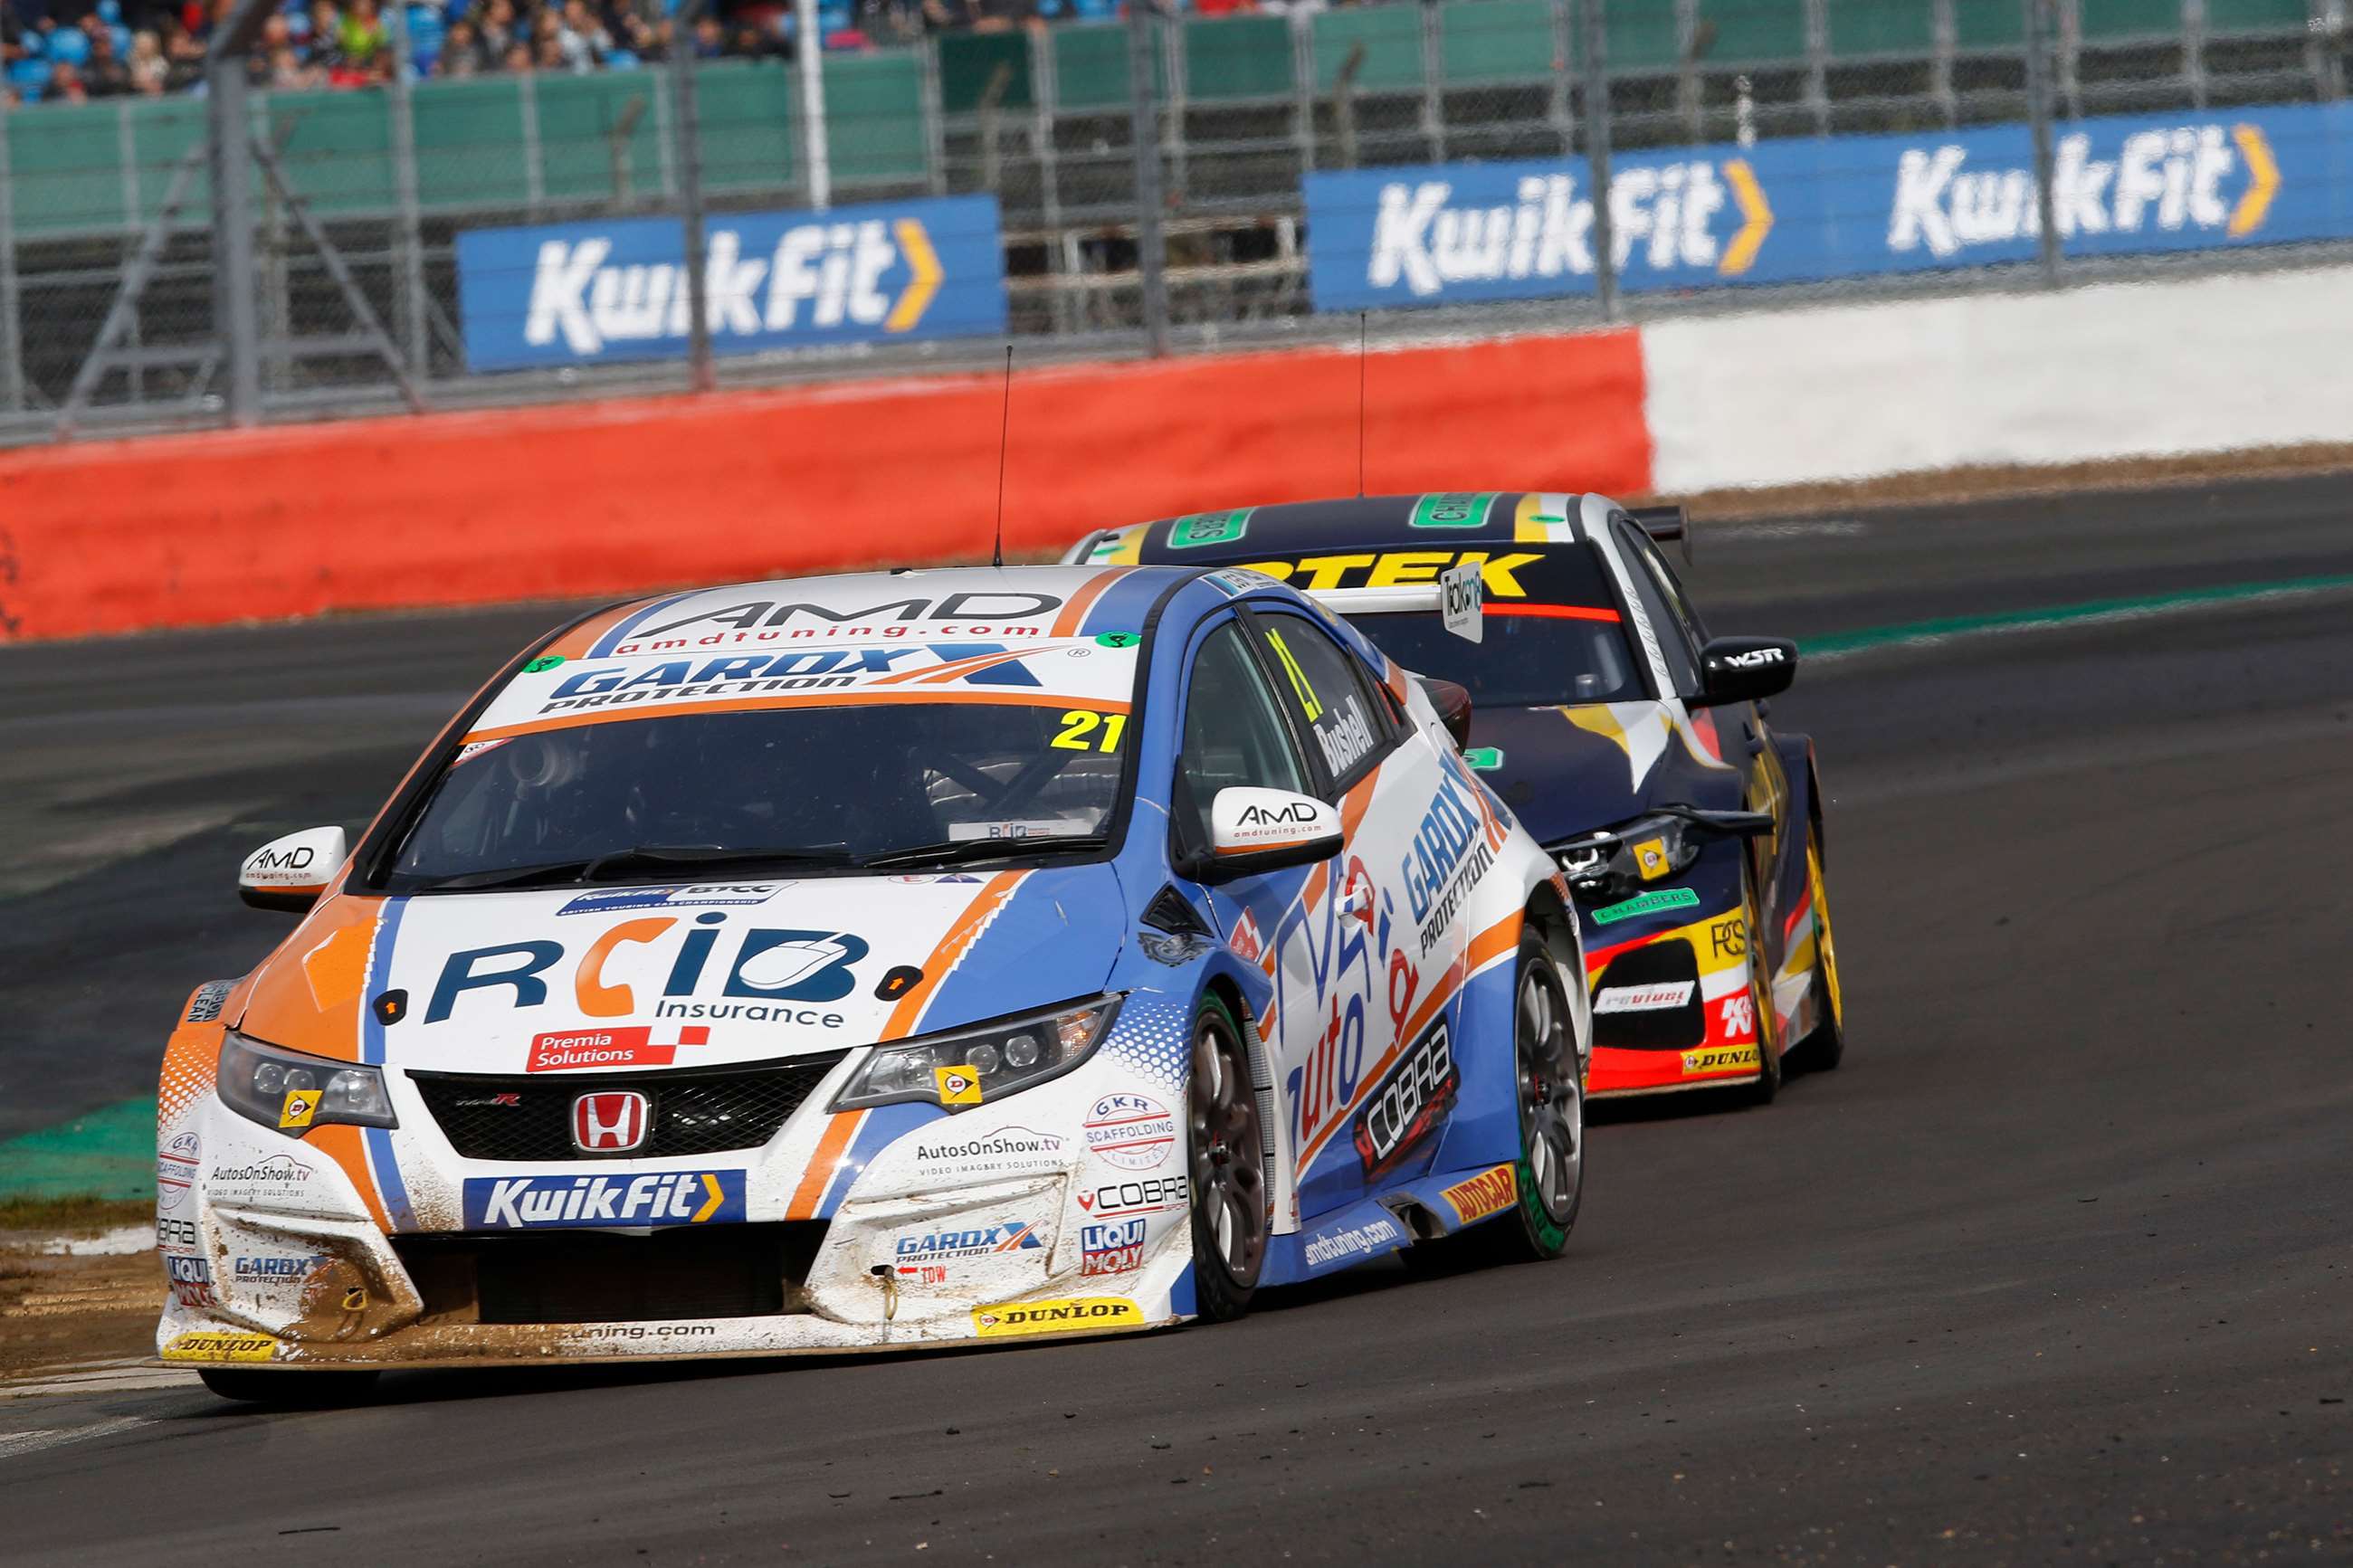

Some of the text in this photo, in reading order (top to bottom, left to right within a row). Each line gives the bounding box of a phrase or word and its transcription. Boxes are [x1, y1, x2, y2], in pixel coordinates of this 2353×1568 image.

[627, 593, 1062, 639] AMD
[615, 624, 1040, 654] amdtuning.com
[1724, 648, 1784, 668] WSR
[1265, 628, 1323, 722] 21
[538, 676, 857, 715] PROTECTION
[1051, 710, 1127, 753] 21
[1313, 695, 1374, 777] Bushell
[1236, 803, 1317, 826] AMD
[1234, 824, 1321, 838] amdtuning.com
[247, 848, 314, 870] AMD
[687, 885, 776, 894] BTCC
[1420, 841, 1495, 960] PROTECTION
[1601, 892, 1691, 918] CHAMBERS
[655, 999, 844, 1028] Insurance
[541, 1033, 612, 1050] Premia
[538, 1045, 634, 1066] Solutions
[1096, 1097, 1148, 1115] GKR
[1087, 1121, 1174, 1143] SCAFFOLDING
[918, 1138, 1060, 1160] AutosOnShow.tv
[211, 1166, 310, 1181] AutosOnShow.tv
[919, 1159, 1064, 1175] VIDEO IMAGERY SOLUTIONS
[207, 1188, 227, 1196] VIDEO
[262, 1189, 304, 1197] SOLUTIONS
[1447, 1168, 1514, 1221] AUTOCAR
[1083, 1221, 1144, 1250] LIQUI
[1305, 1220, 1397, 1265] amdtuning.com
[896, 1248, 989, 1264] PROTECTION
[1084, 1246, 1142, 1275] MOLY
[235, 1275, 301, 1284] PROTECTION
[921, 1265, 947, 1284] TOW
[1005, 1304, 1129, 1324] DUNLOP
[181, 1339, 272, 1352] DUNLOP
